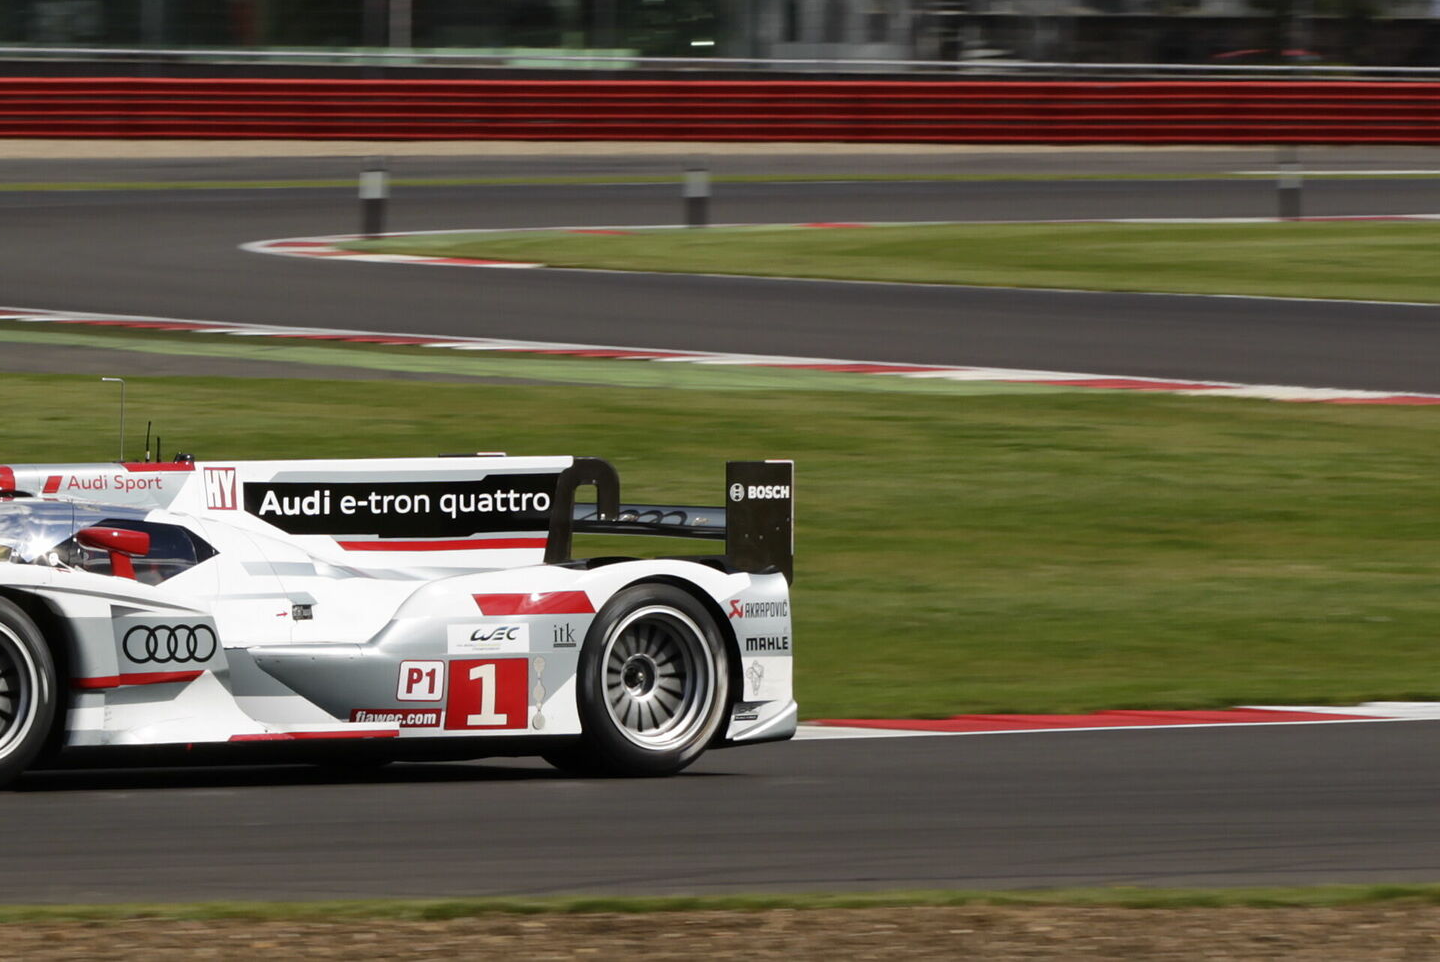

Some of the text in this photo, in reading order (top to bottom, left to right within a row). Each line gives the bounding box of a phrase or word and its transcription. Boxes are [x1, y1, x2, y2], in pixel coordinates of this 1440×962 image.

[67, 475, 163, 493] Audi Sport
[205, 469, 235, 509] HY
[747, 485, 790, 499] BOSCH
[259, 489, 551, 519] Audi e-tron quattro
[470, 626, 521, 642] WEC
[553, 623, 577, 643] itk
[746, 637, 789, 651] MAHLE
[406, 668, 436, 695] P1
[466, 663, 508, 726] 1
[355, 710, 437, 725] fiawec.com
